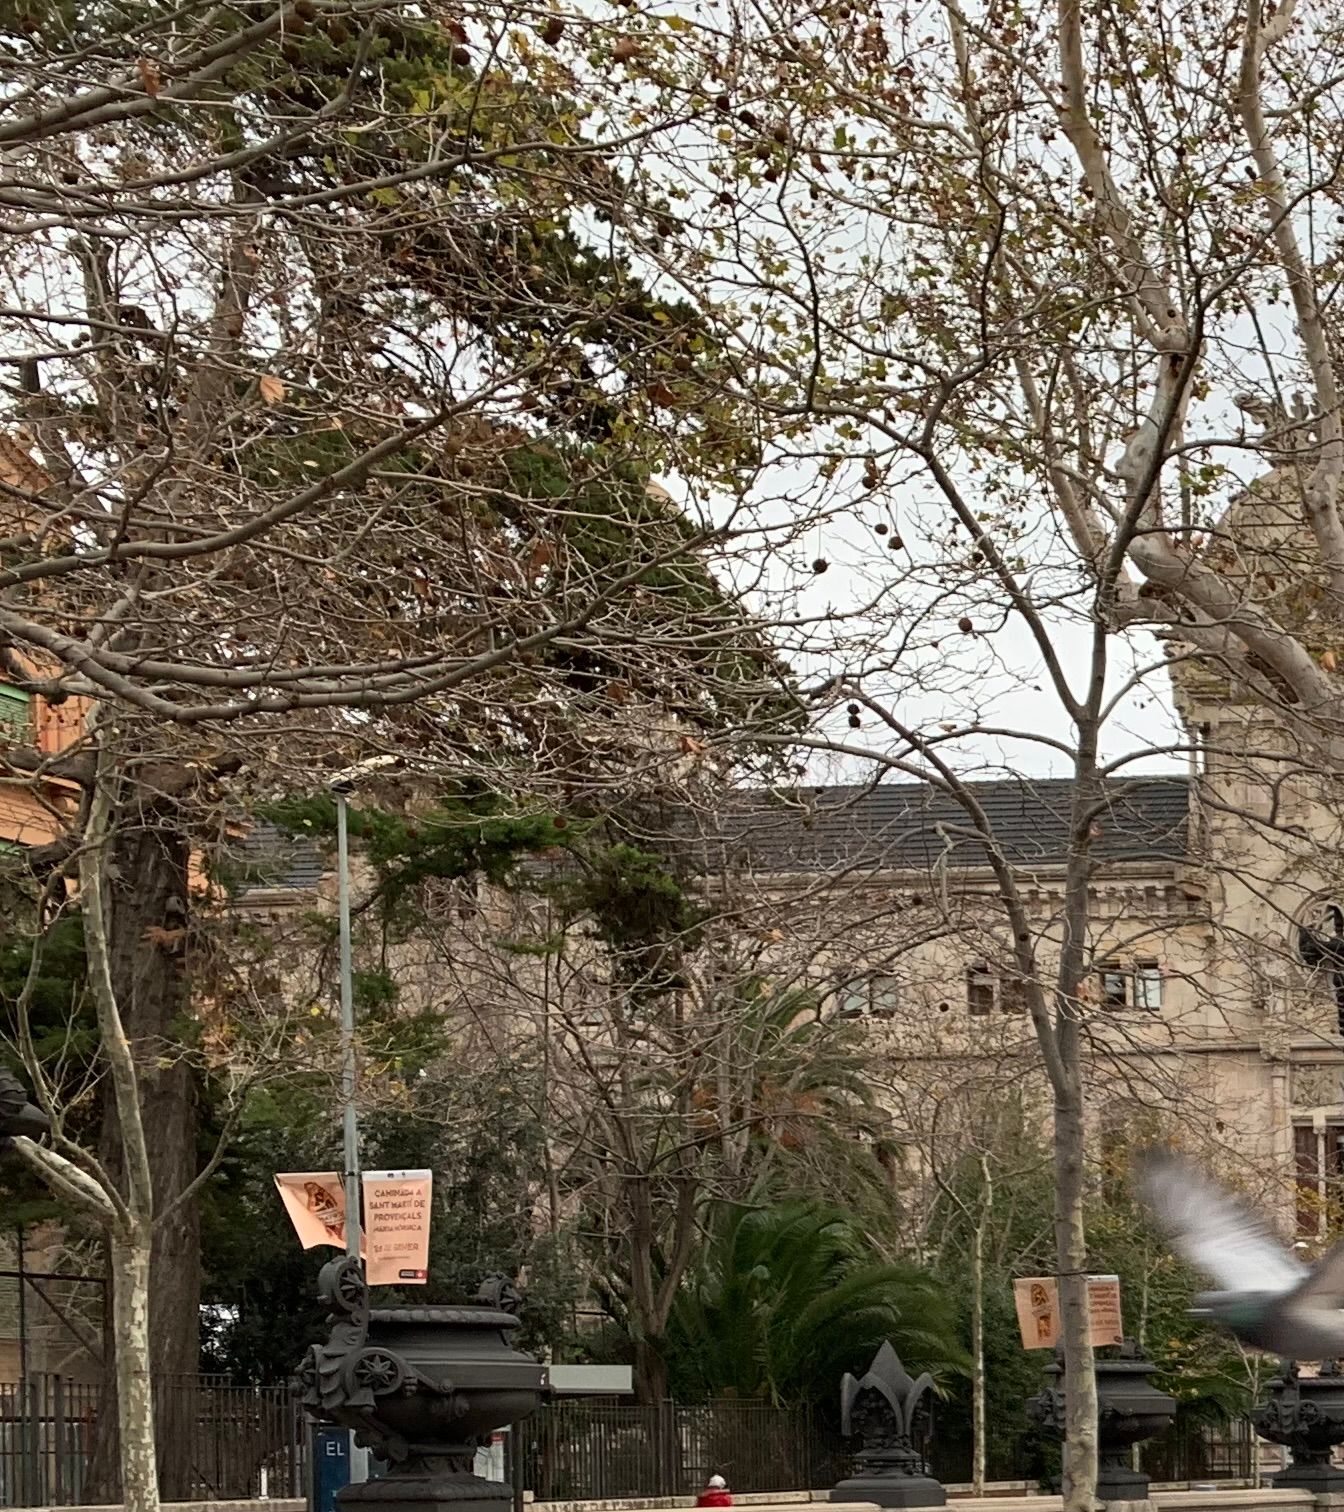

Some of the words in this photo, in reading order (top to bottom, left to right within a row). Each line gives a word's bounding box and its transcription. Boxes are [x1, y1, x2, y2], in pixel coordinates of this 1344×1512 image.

[369, 1201, 390, 1211] SANT
[414, 1199, 426, 1208] DE
[326, 1441, 345, 1456] EL
